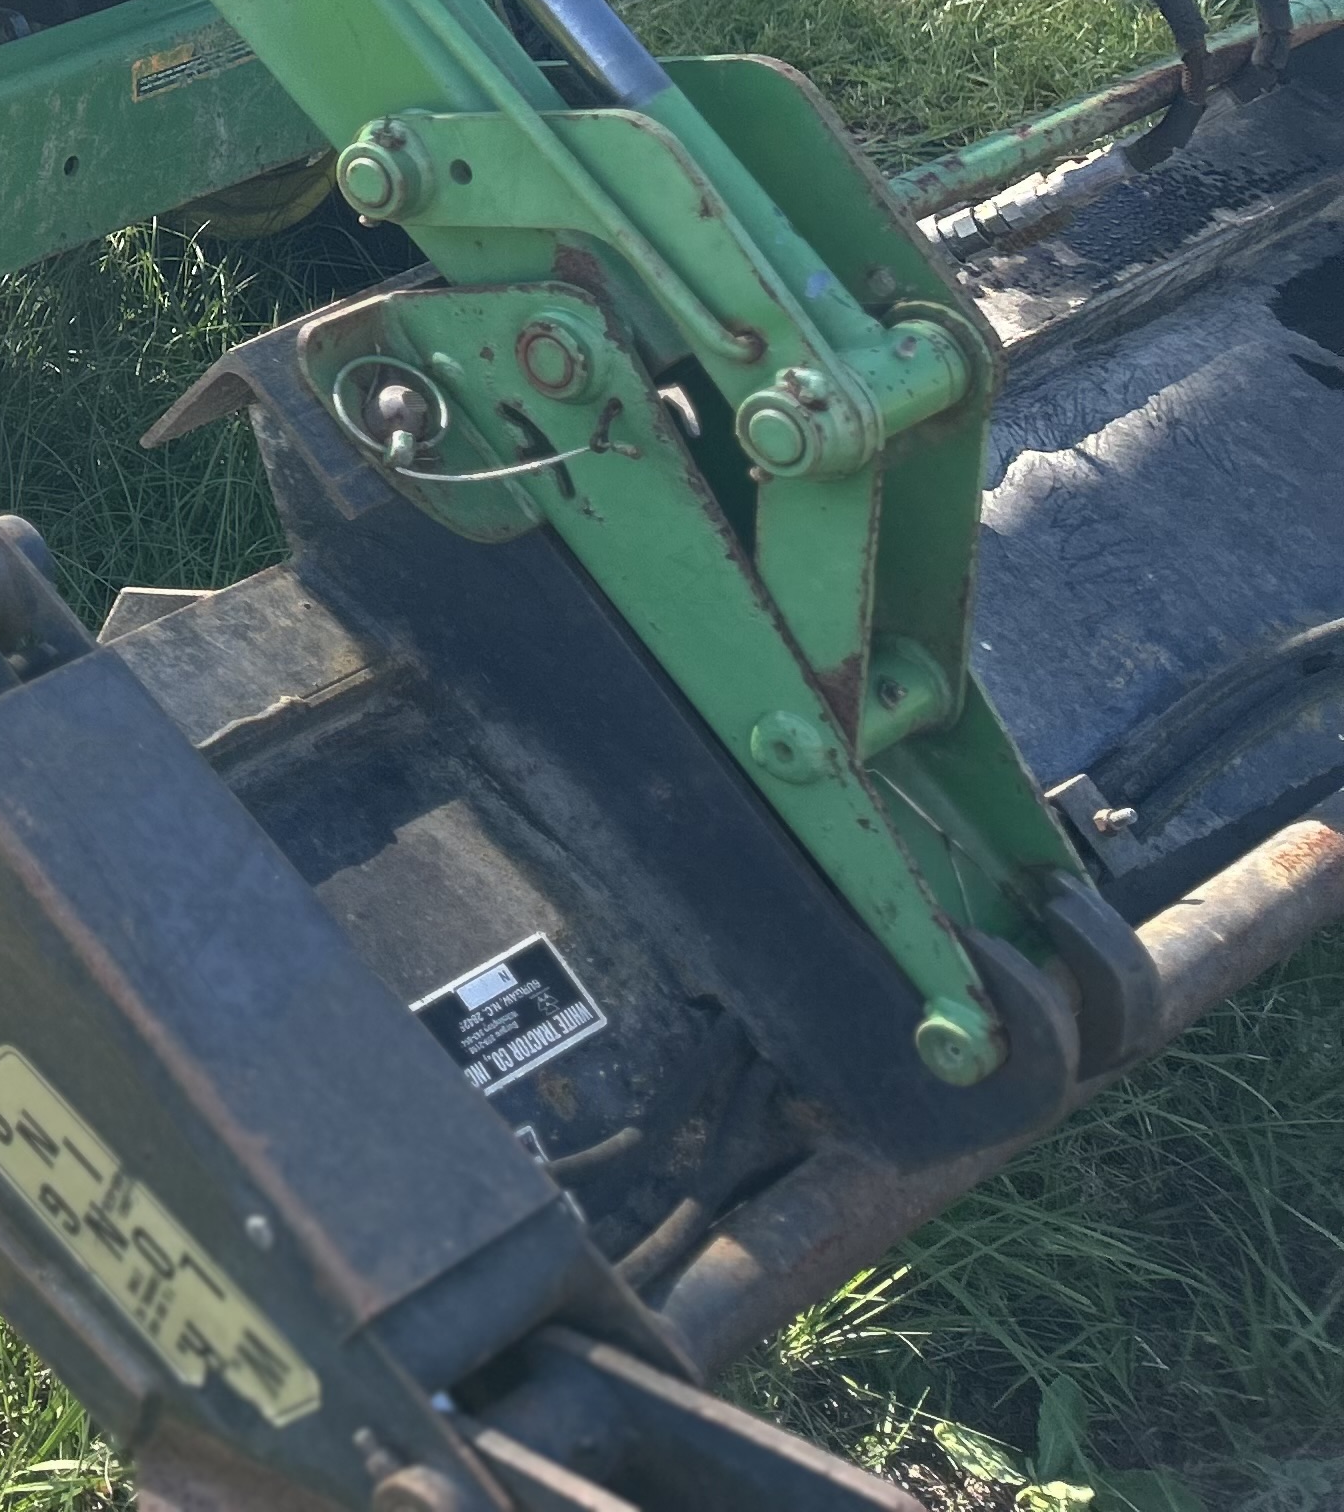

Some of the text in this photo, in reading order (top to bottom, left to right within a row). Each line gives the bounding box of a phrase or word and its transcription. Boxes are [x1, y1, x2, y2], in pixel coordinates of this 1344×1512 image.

[553, 1002, 593, 1034] WHITE
[507, 1021, 561, 1061] TRACTOR
[483, 1048, 514, 1071] CO.,
[38, 1183, 226, 1303] LONG
